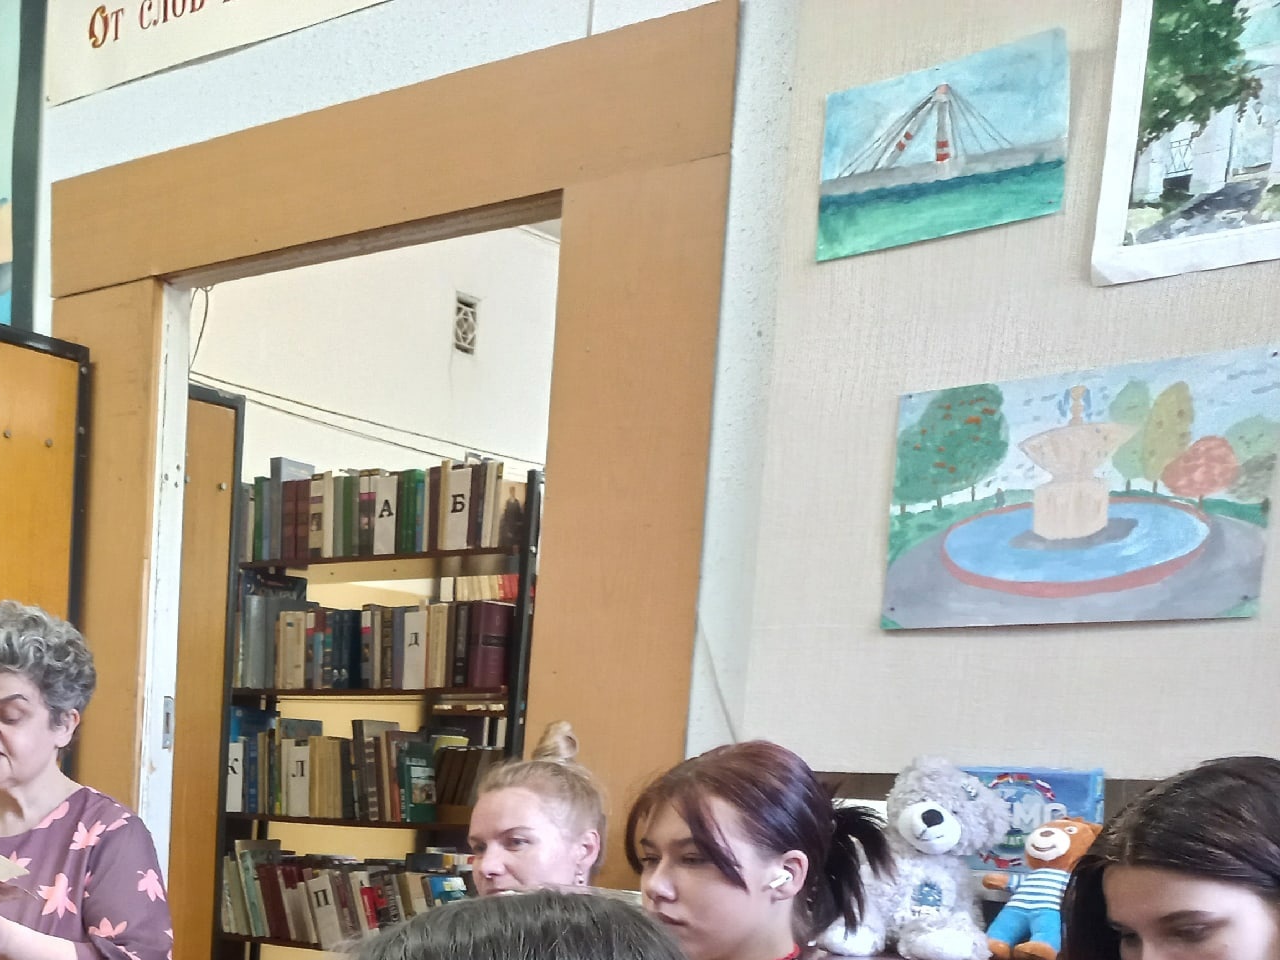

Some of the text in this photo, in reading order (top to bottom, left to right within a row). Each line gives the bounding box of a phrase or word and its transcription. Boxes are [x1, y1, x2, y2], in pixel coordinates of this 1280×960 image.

[378, 499, 394, 518] А
[450, 493, 465, 513] Б
[291, 760, 306, 778] Л
[312, 888, 331, 908] П
